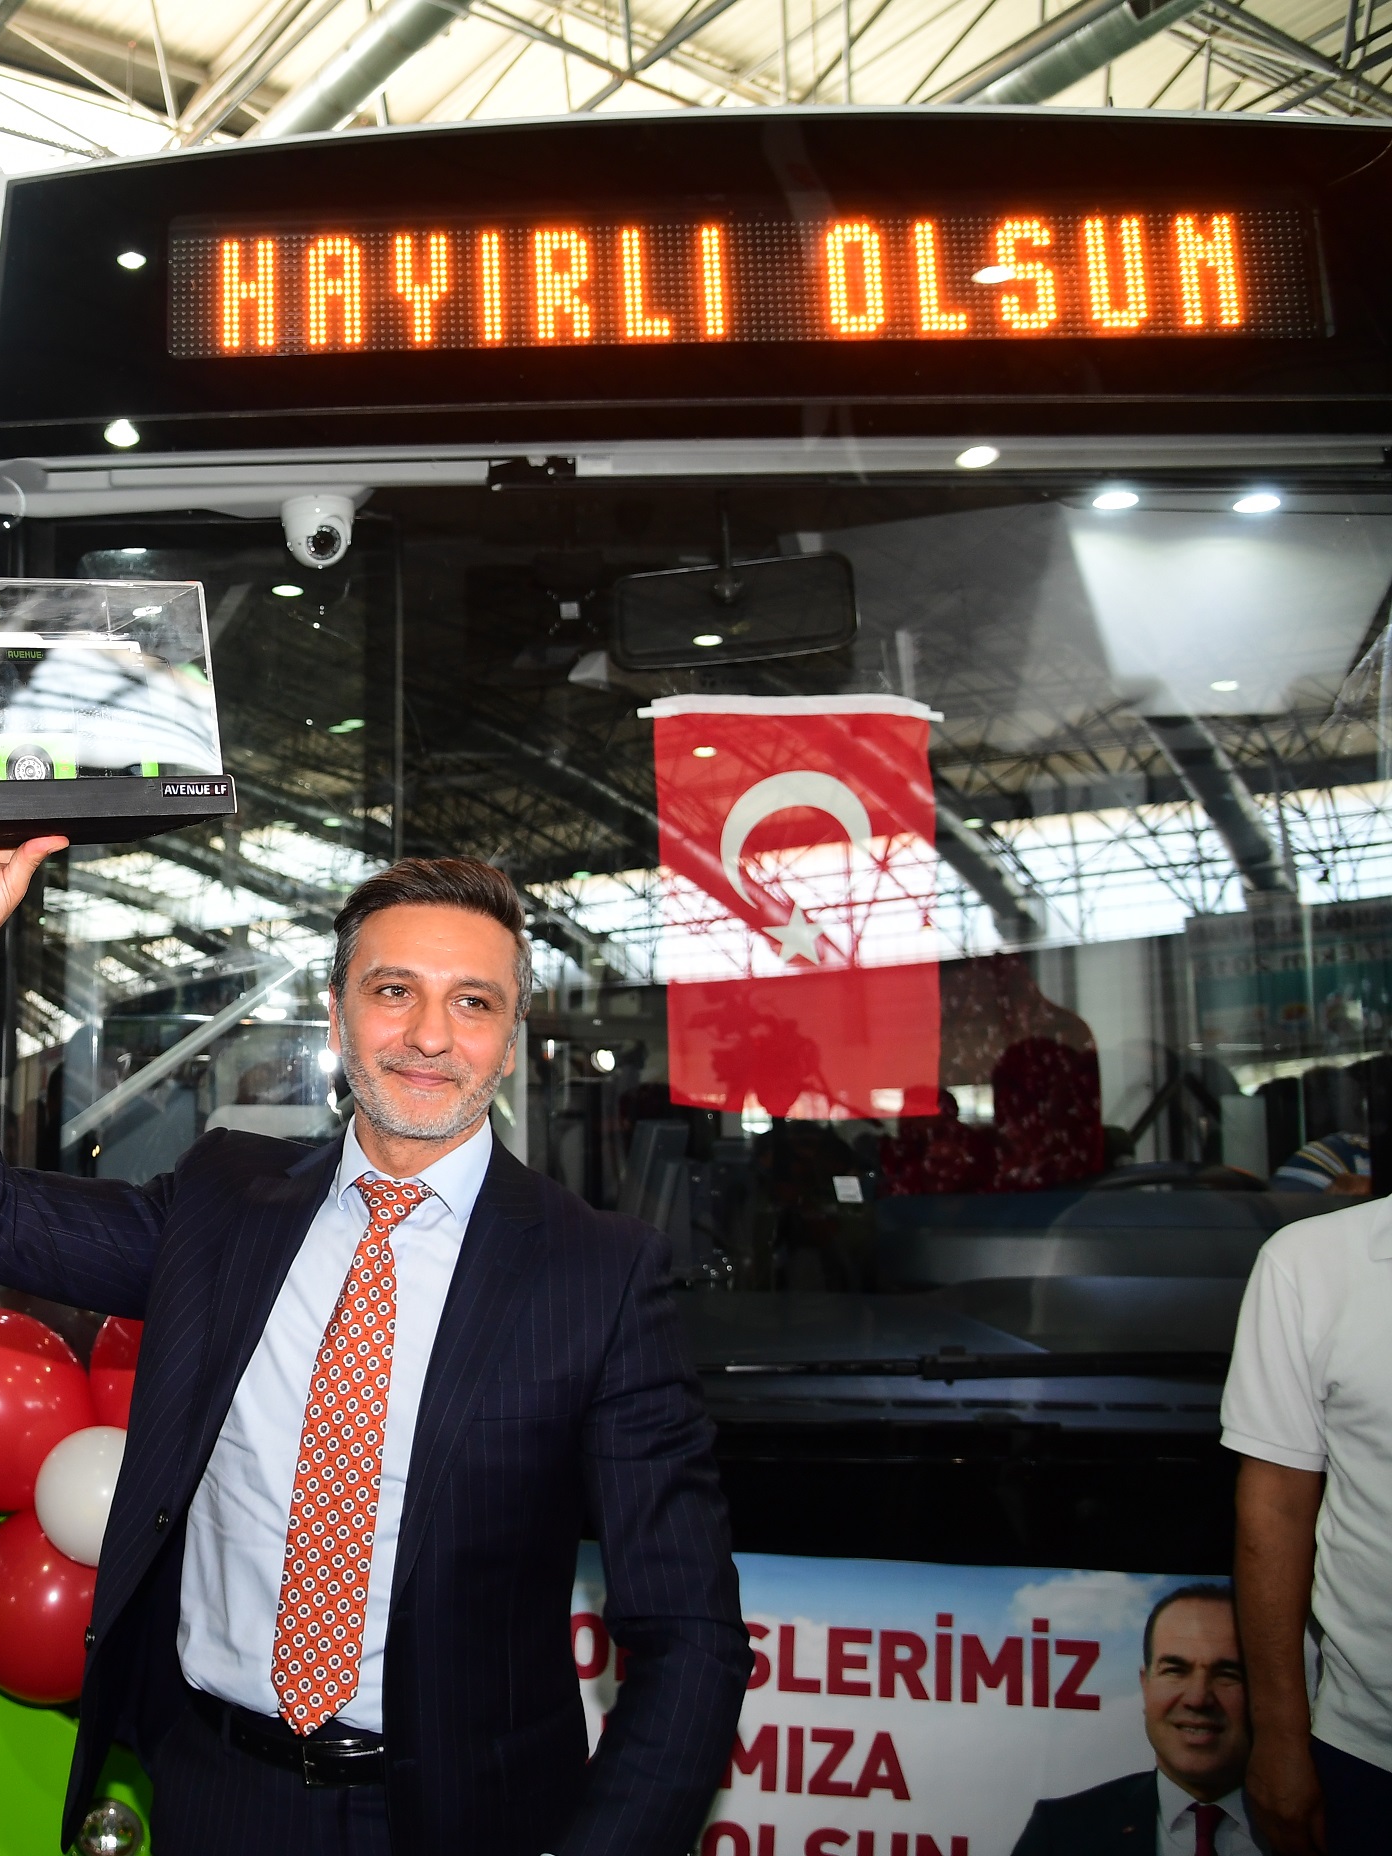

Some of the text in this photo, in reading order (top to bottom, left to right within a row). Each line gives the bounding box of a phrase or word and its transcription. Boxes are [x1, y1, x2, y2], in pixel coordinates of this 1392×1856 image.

[217, 213, 1247, 349] HAYIRLI OLSUN
[164, 784, 227, 796] AVENUE LF
[571, 1610, 1101, 1712] OSLERİMİZ
[718, 1723, 912, 1801] MIZA
